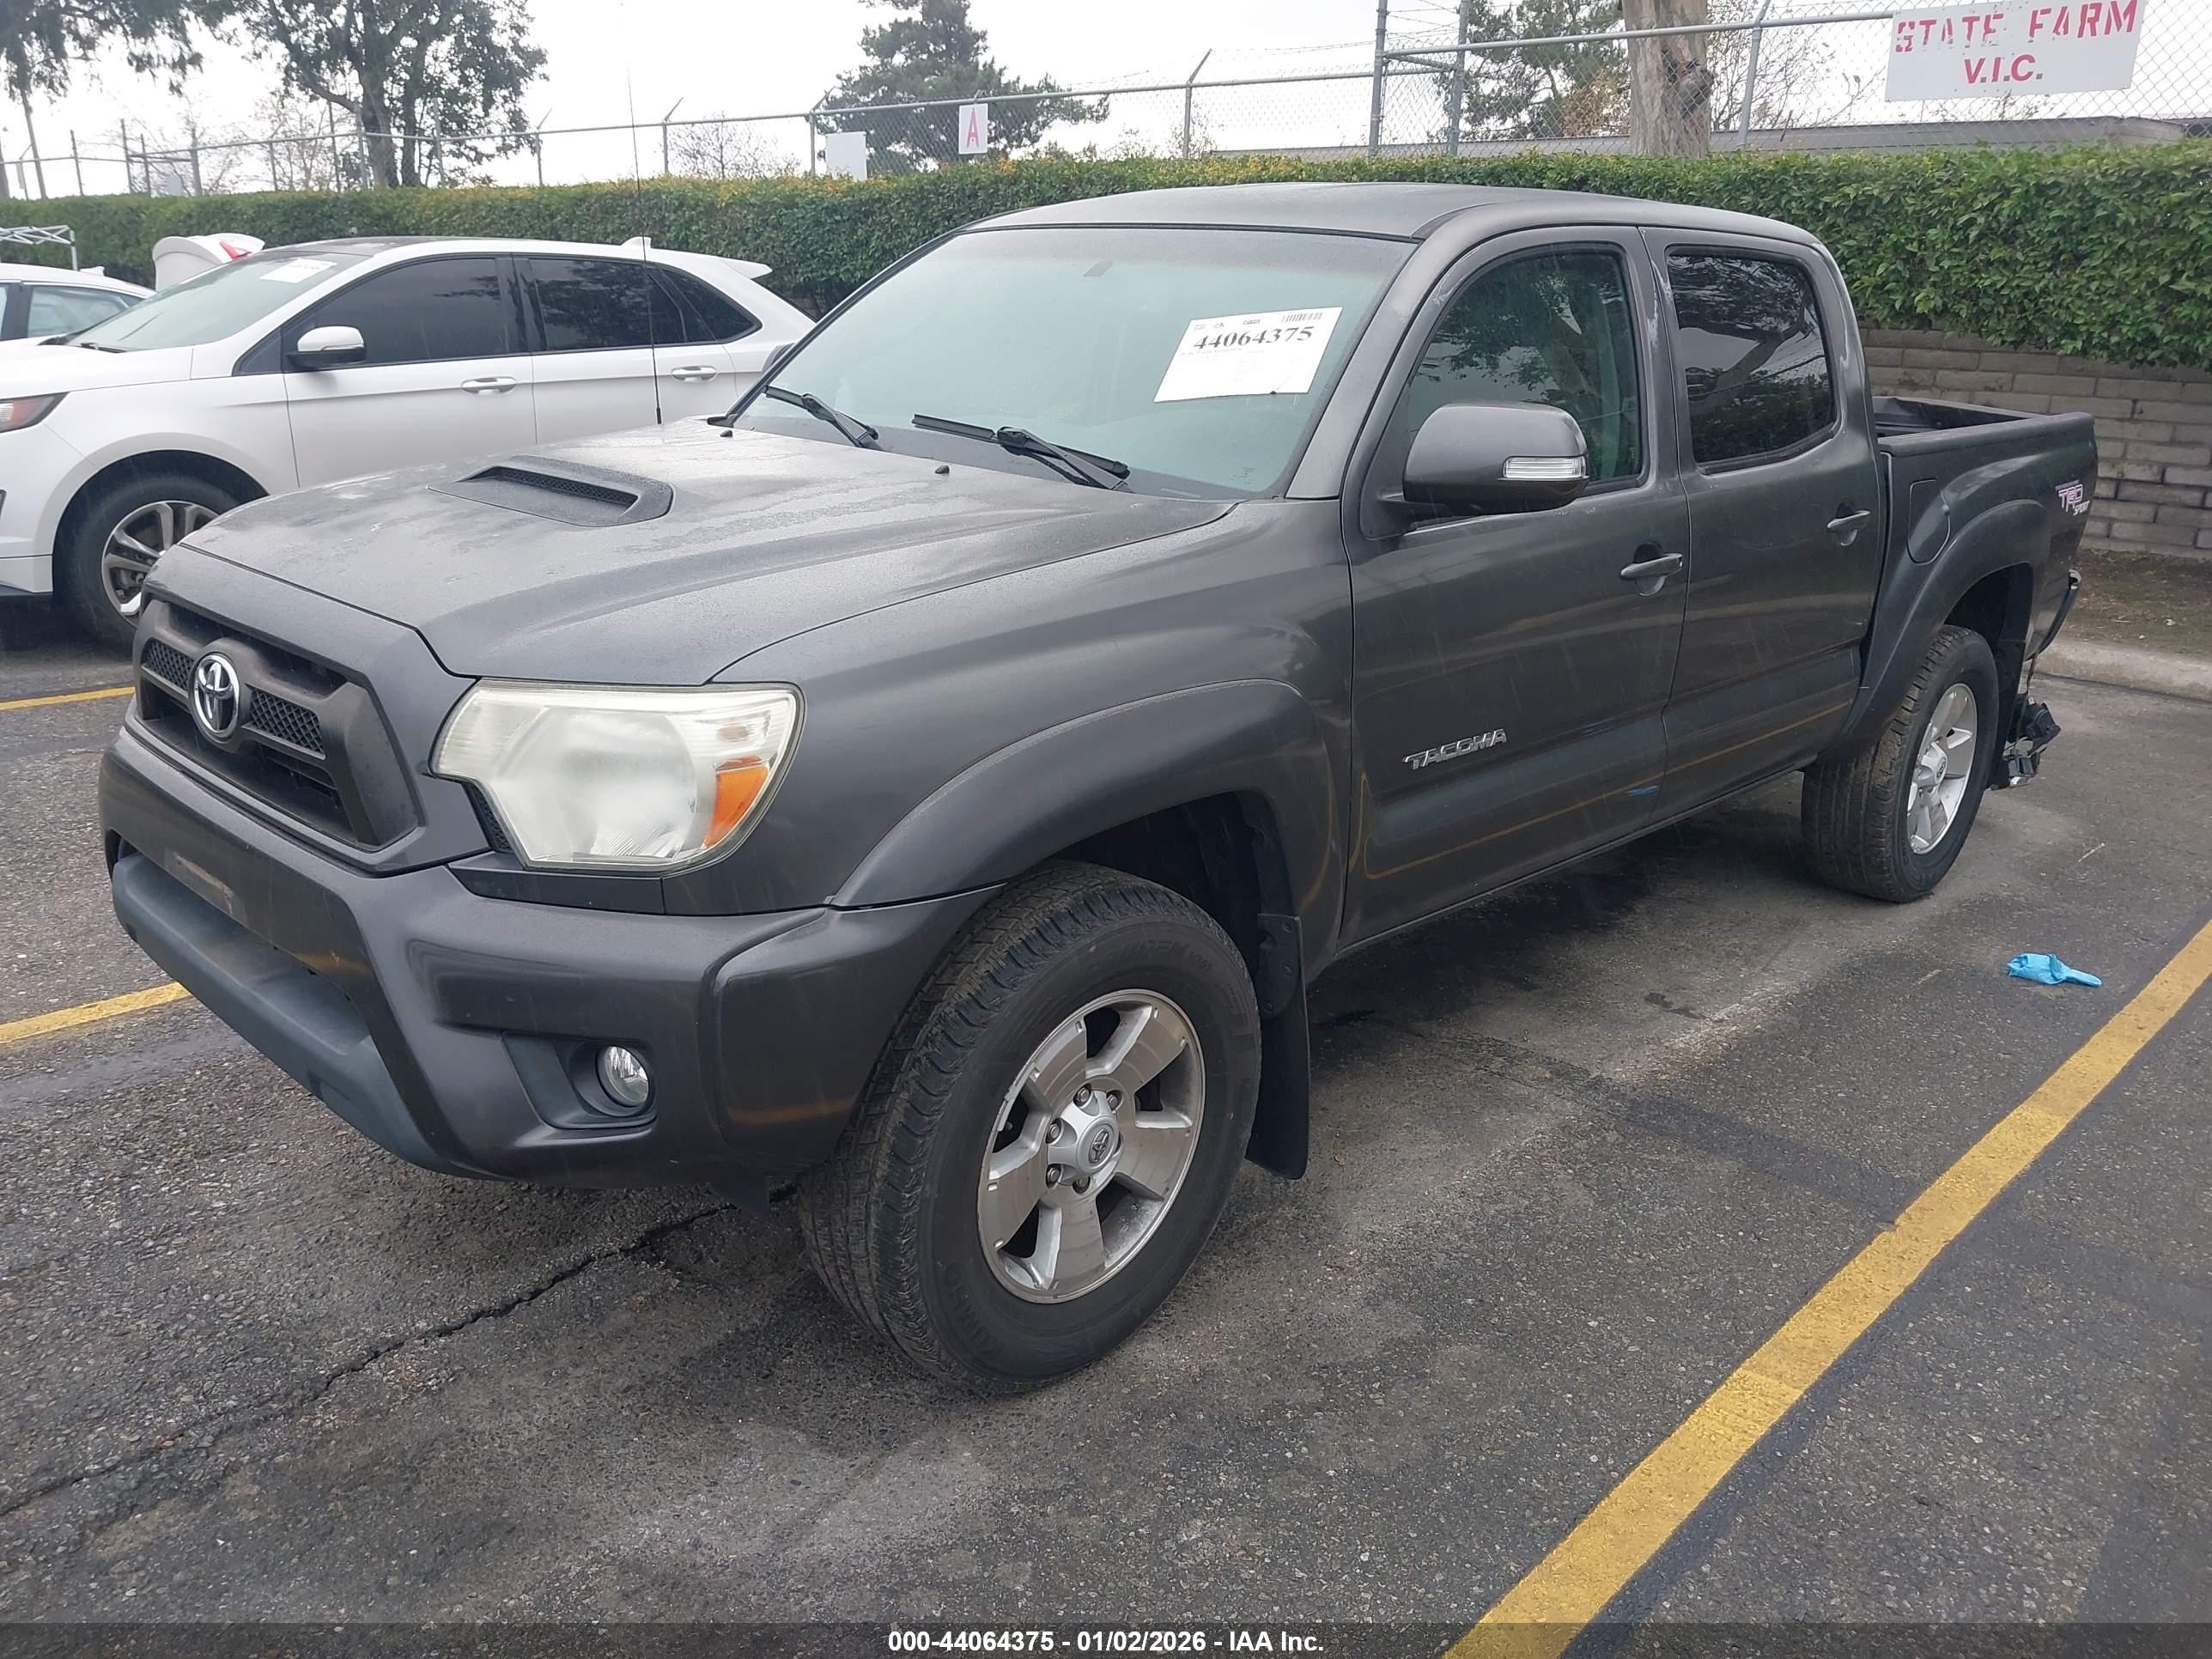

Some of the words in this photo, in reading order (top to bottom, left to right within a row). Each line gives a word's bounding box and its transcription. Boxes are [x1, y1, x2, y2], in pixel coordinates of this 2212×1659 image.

[1895, 13, 2004, 52] STATE
[2028, 0, 2138, 42] FARM
[1964, 54, 2044, 83] V.I.C.
[966, 107, 980, 148] A
[1193, 325, 1315, 349] 44064375
[2058, 483, 2083, 513] TRD
[1402, 728, 1507, 769] TACOMA
